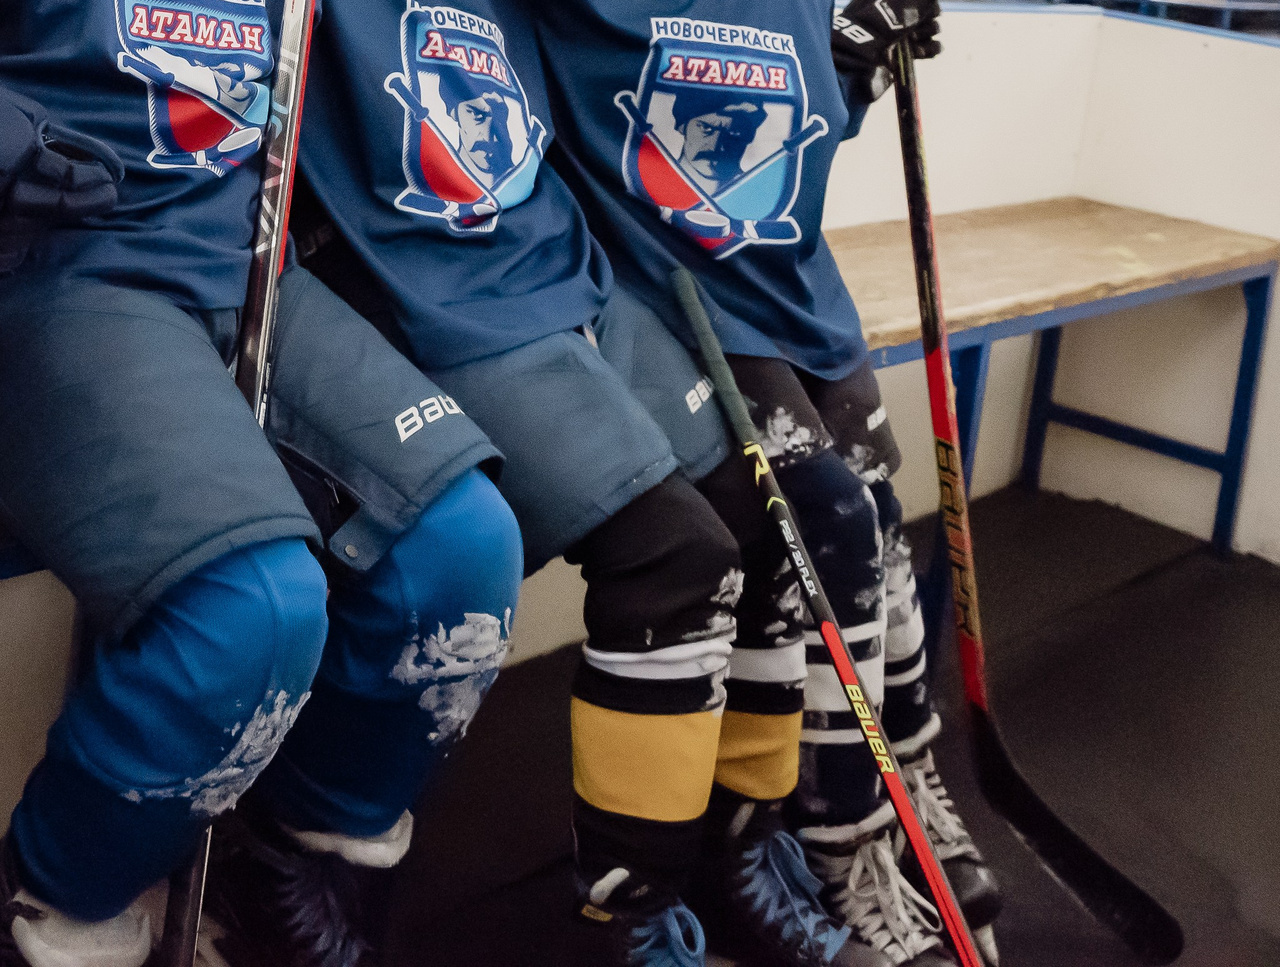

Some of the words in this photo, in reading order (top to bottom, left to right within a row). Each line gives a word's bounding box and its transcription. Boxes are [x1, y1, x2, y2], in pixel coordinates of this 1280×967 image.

[129, 6, 264, 53] АТАМАН
[655, 20, 794, 52] НОВОЧЕРКАССК
[421, 31, 511, 87] ААМА
[662, 55, 788, 90] АТАМАН
[845, 684, 895, 773] BAUER
